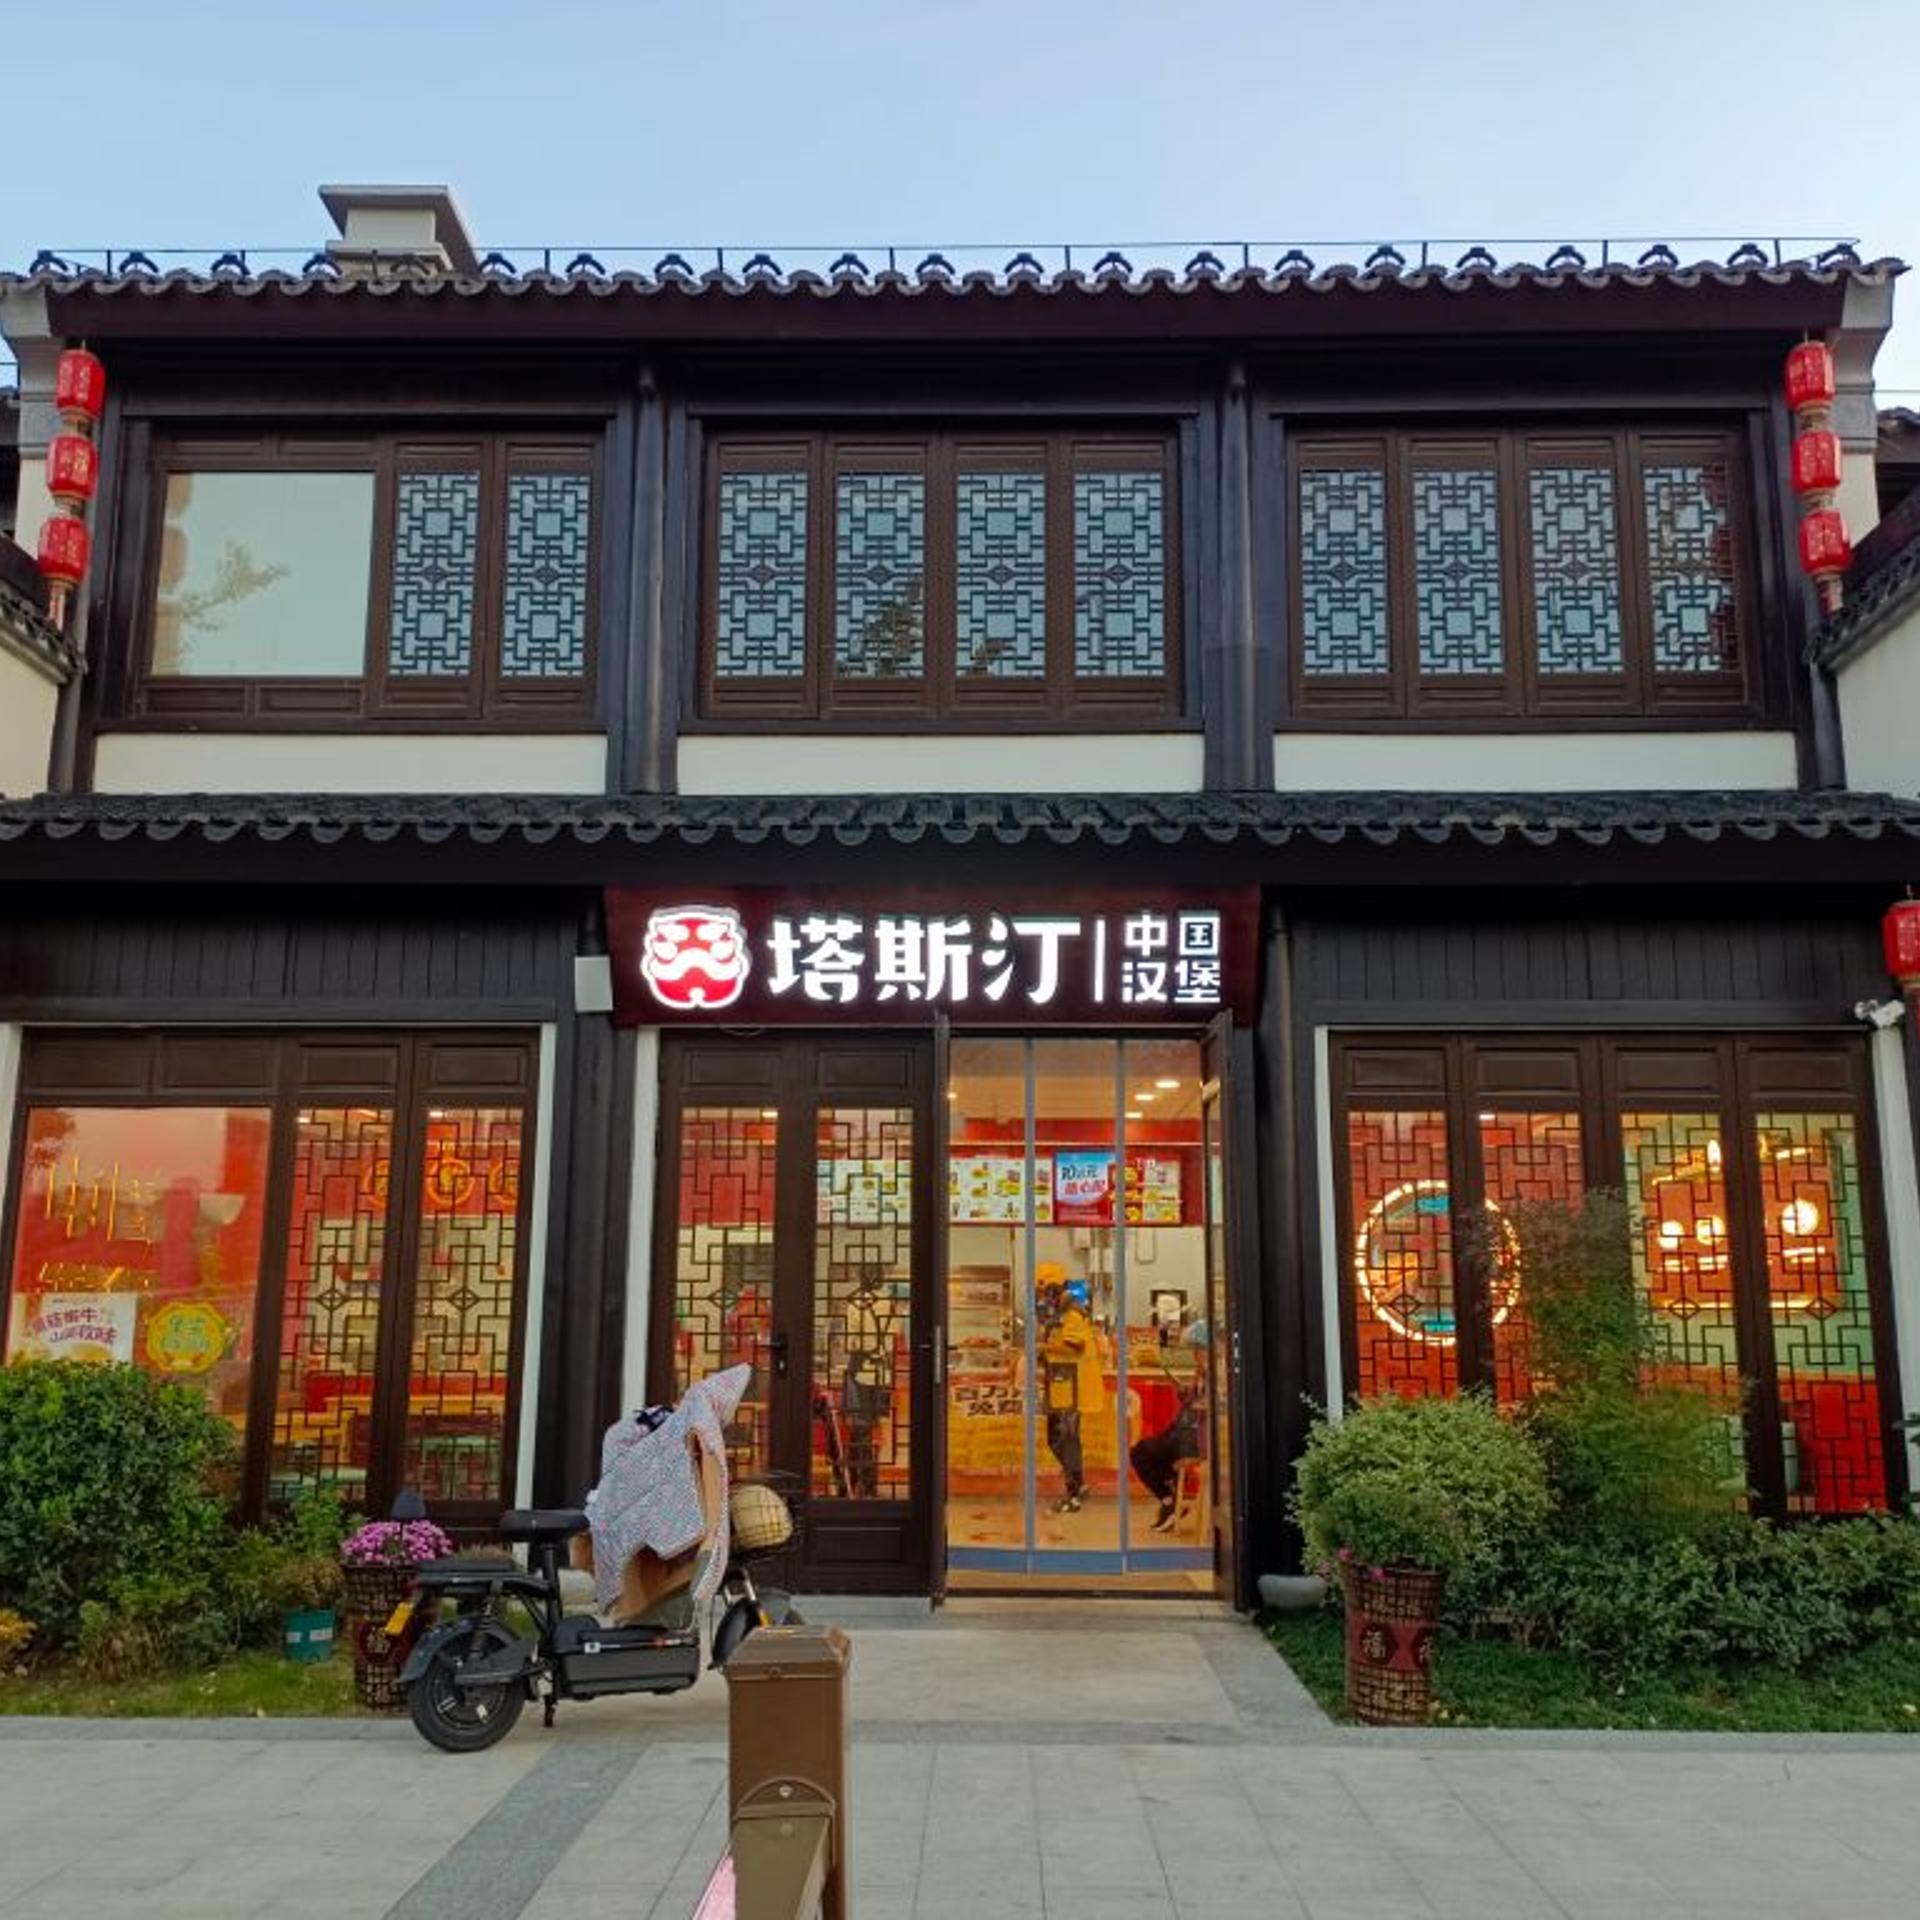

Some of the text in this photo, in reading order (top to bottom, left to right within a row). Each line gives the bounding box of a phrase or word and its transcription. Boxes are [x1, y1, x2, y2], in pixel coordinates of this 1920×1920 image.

[1124, 913, 1221, 957] 中国
[766, 916, 1081, 1004] 塔斯汀
[1121, 961, 1221, 1004] 汉堡
